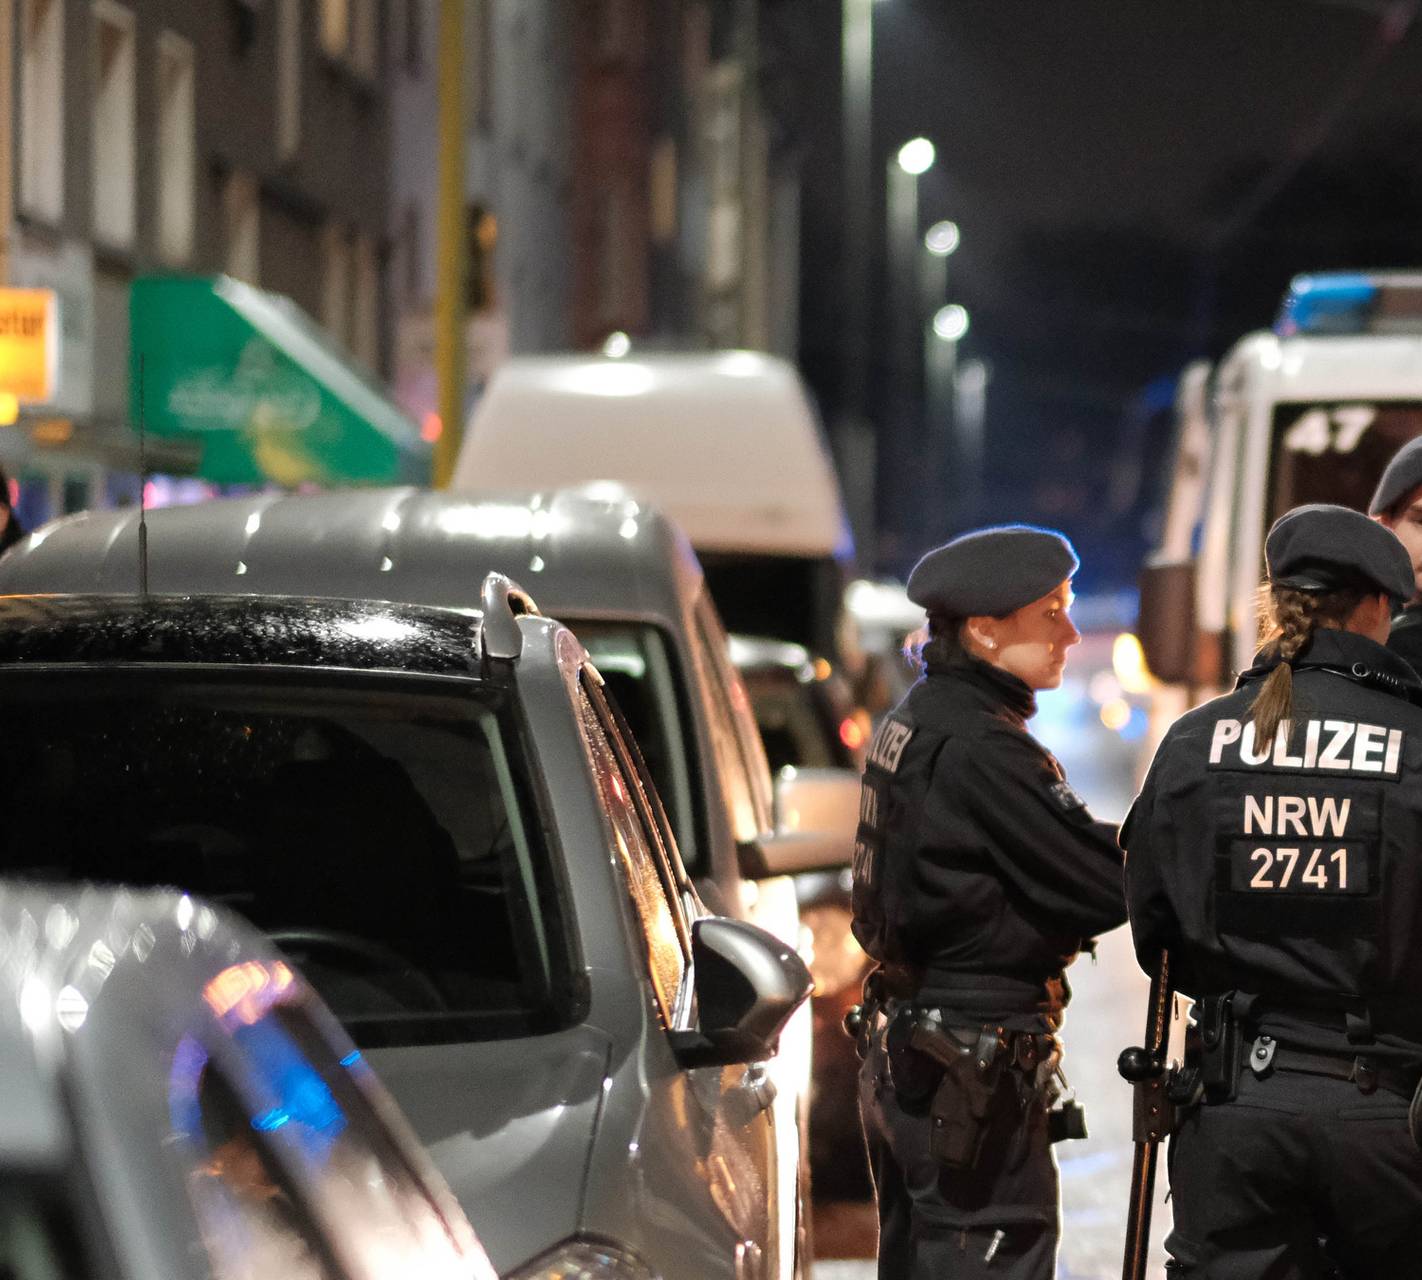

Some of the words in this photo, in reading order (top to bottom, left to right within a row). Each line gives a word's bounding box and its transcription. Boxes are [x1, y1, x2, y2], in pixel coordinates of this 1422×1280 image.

[1284, 408, 1376, 454] 47
[1208, 719, 1403, 774] POLIZEI
[1243, 795, 1351, 838] NRW
[1250, 848, 1347, 889] 2741
